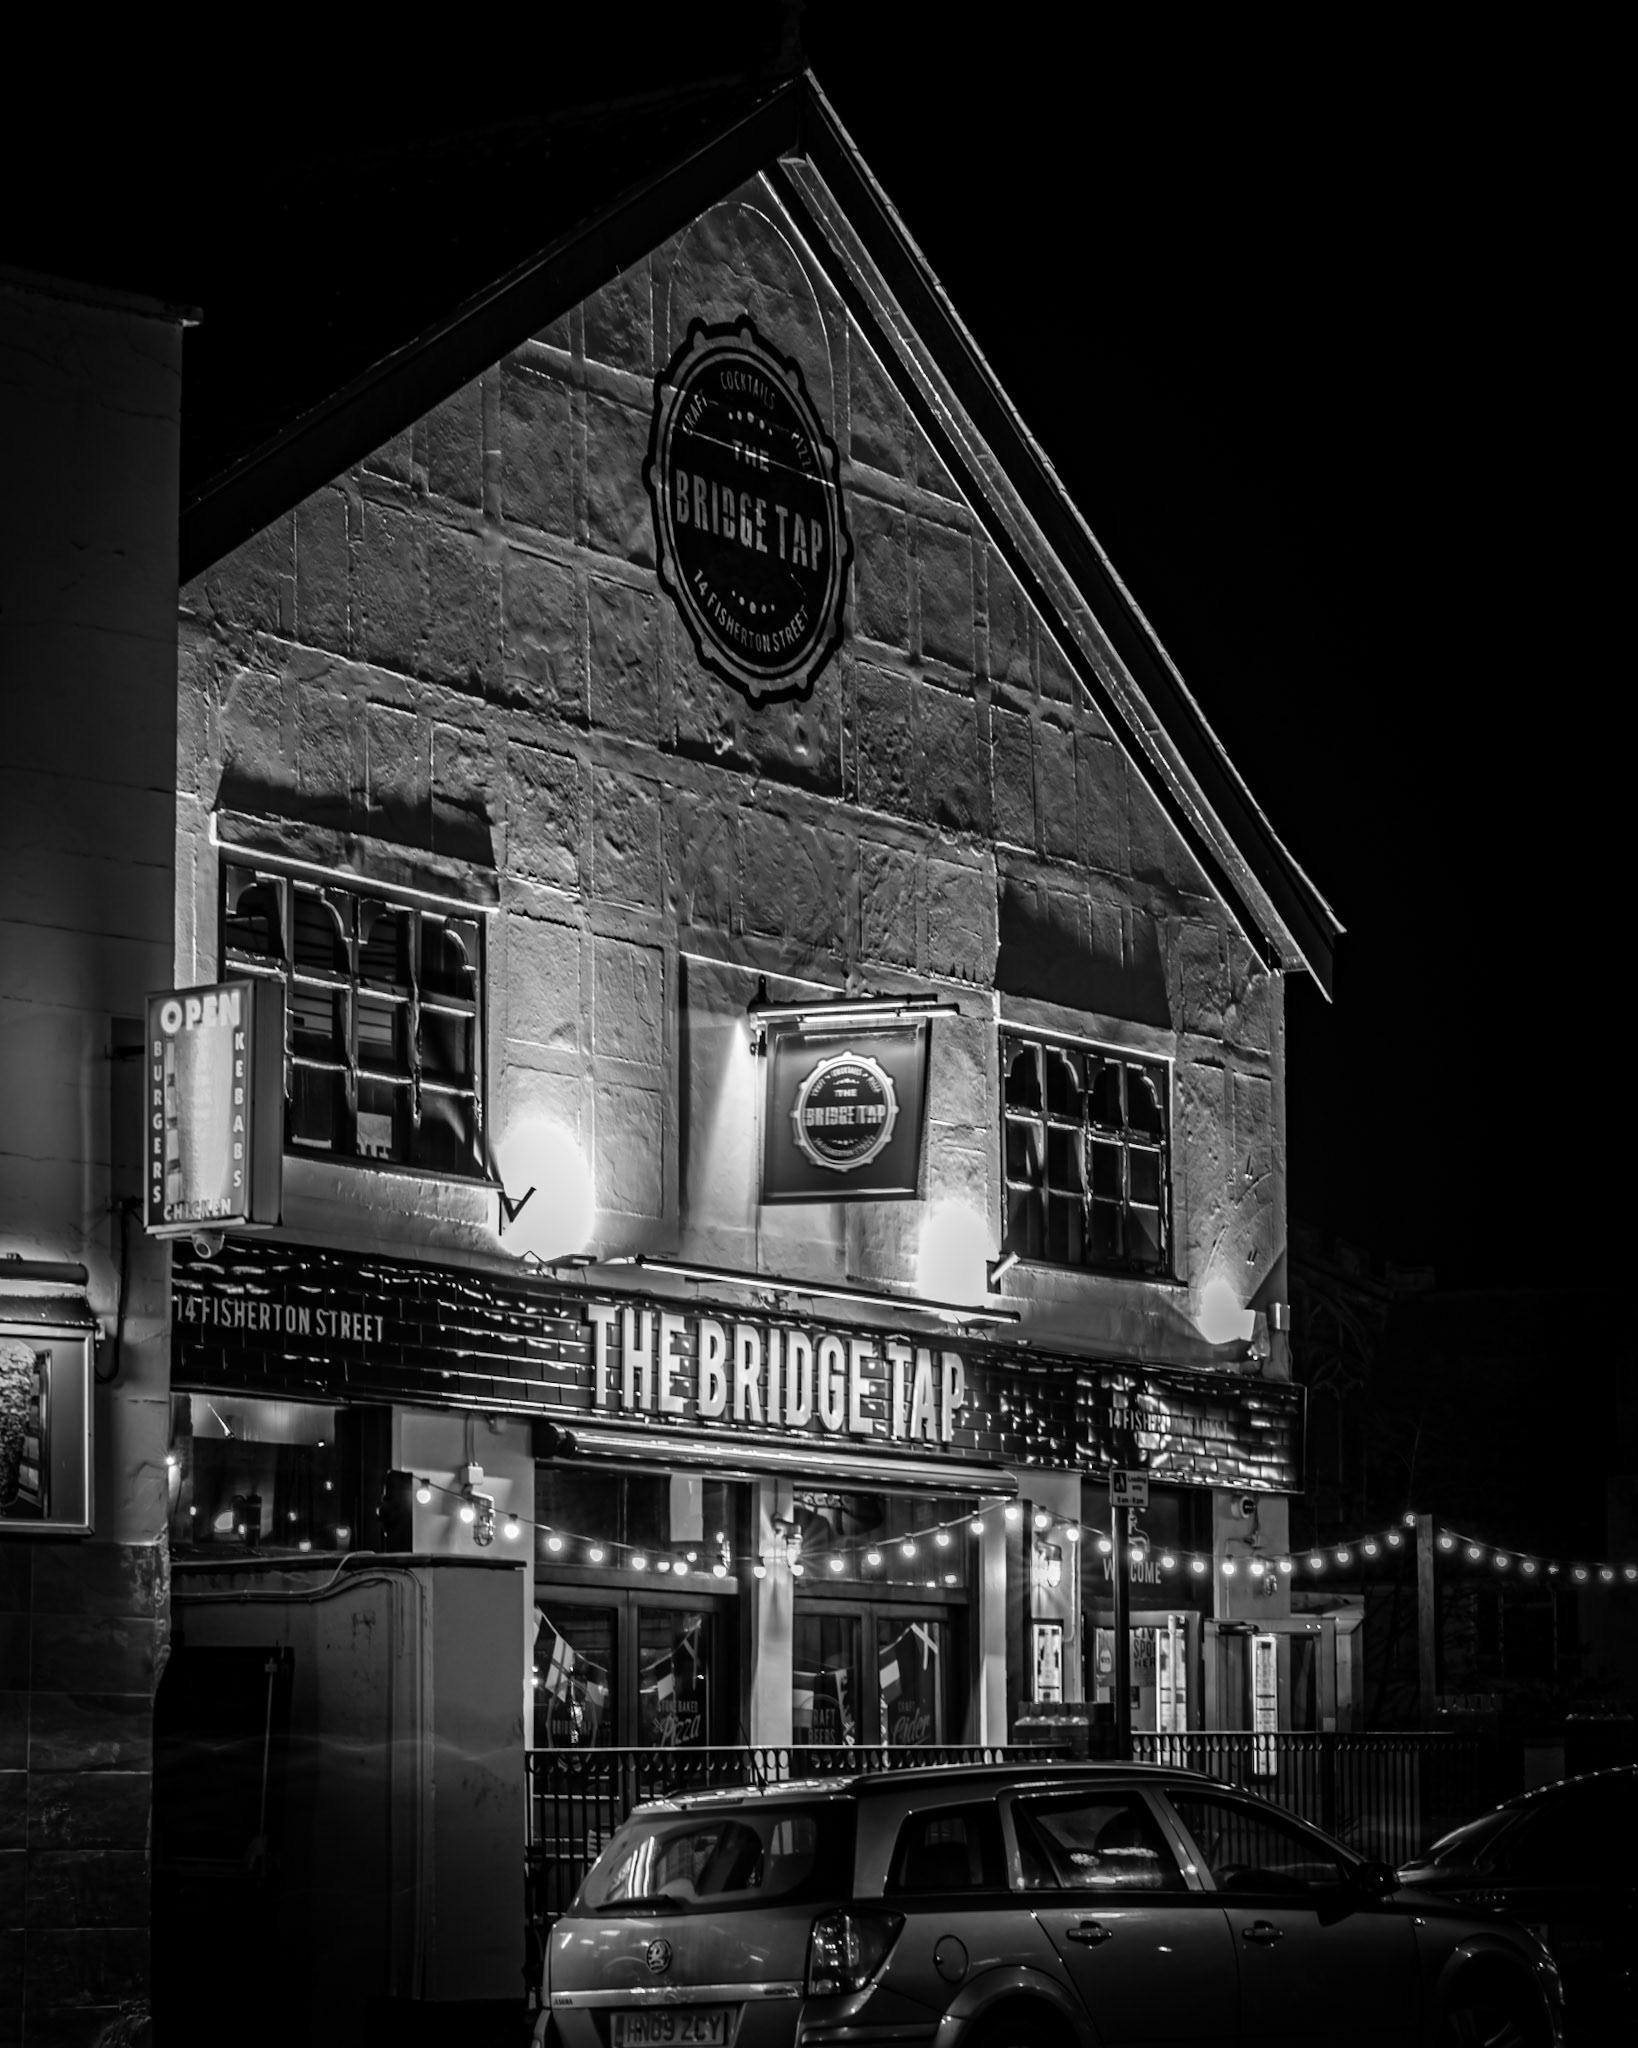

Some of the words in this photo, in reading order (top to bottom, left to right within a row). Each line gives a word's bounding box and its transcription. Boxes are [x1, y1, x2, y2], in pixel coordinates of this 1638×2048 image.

[682, 388, 708, 436] CRAFT
[720, 370, 776, 410] COCKTAILS
[733, 438, 770, 473] THE
[675, 467, 768, 554] BRIDGE
[775, 503, 824, 573] TAP
[693, 568, 707, 598] 14
[706, 597, 771, 653] FISHERTON
[770, 604, 810, 653] STREET
[161, 992, 240, 1034] OPEN
[233, 1032, 245, 1188] KEBABS
[834, 1089, 857, 1097] THE
[153, 1041, 163, 1203] BURGERS
[804, 1106, 855, 1126] BRIDGE
[856, 1104, 886, 1125] TAP
[163, 1198, 231, 1221] CHICKEN
[177, 1294, 196, 1322] 14
[201, 1297, 310, 1335] FISHERTON
[315, 1307, 384, 1343] STREET
[587, 1303, 688, 1414] THE
[698, 1318, 876, 1434] BRIDGE
[886, 1342, 966, 1443] TAP
[1108, 1408, 1120, 1428] 14
[1103, 1558, 1161, 1584] WCOME
[626, 2014, 675, 2043] HN09
[681, 2014, 721, 2042] ZCY
